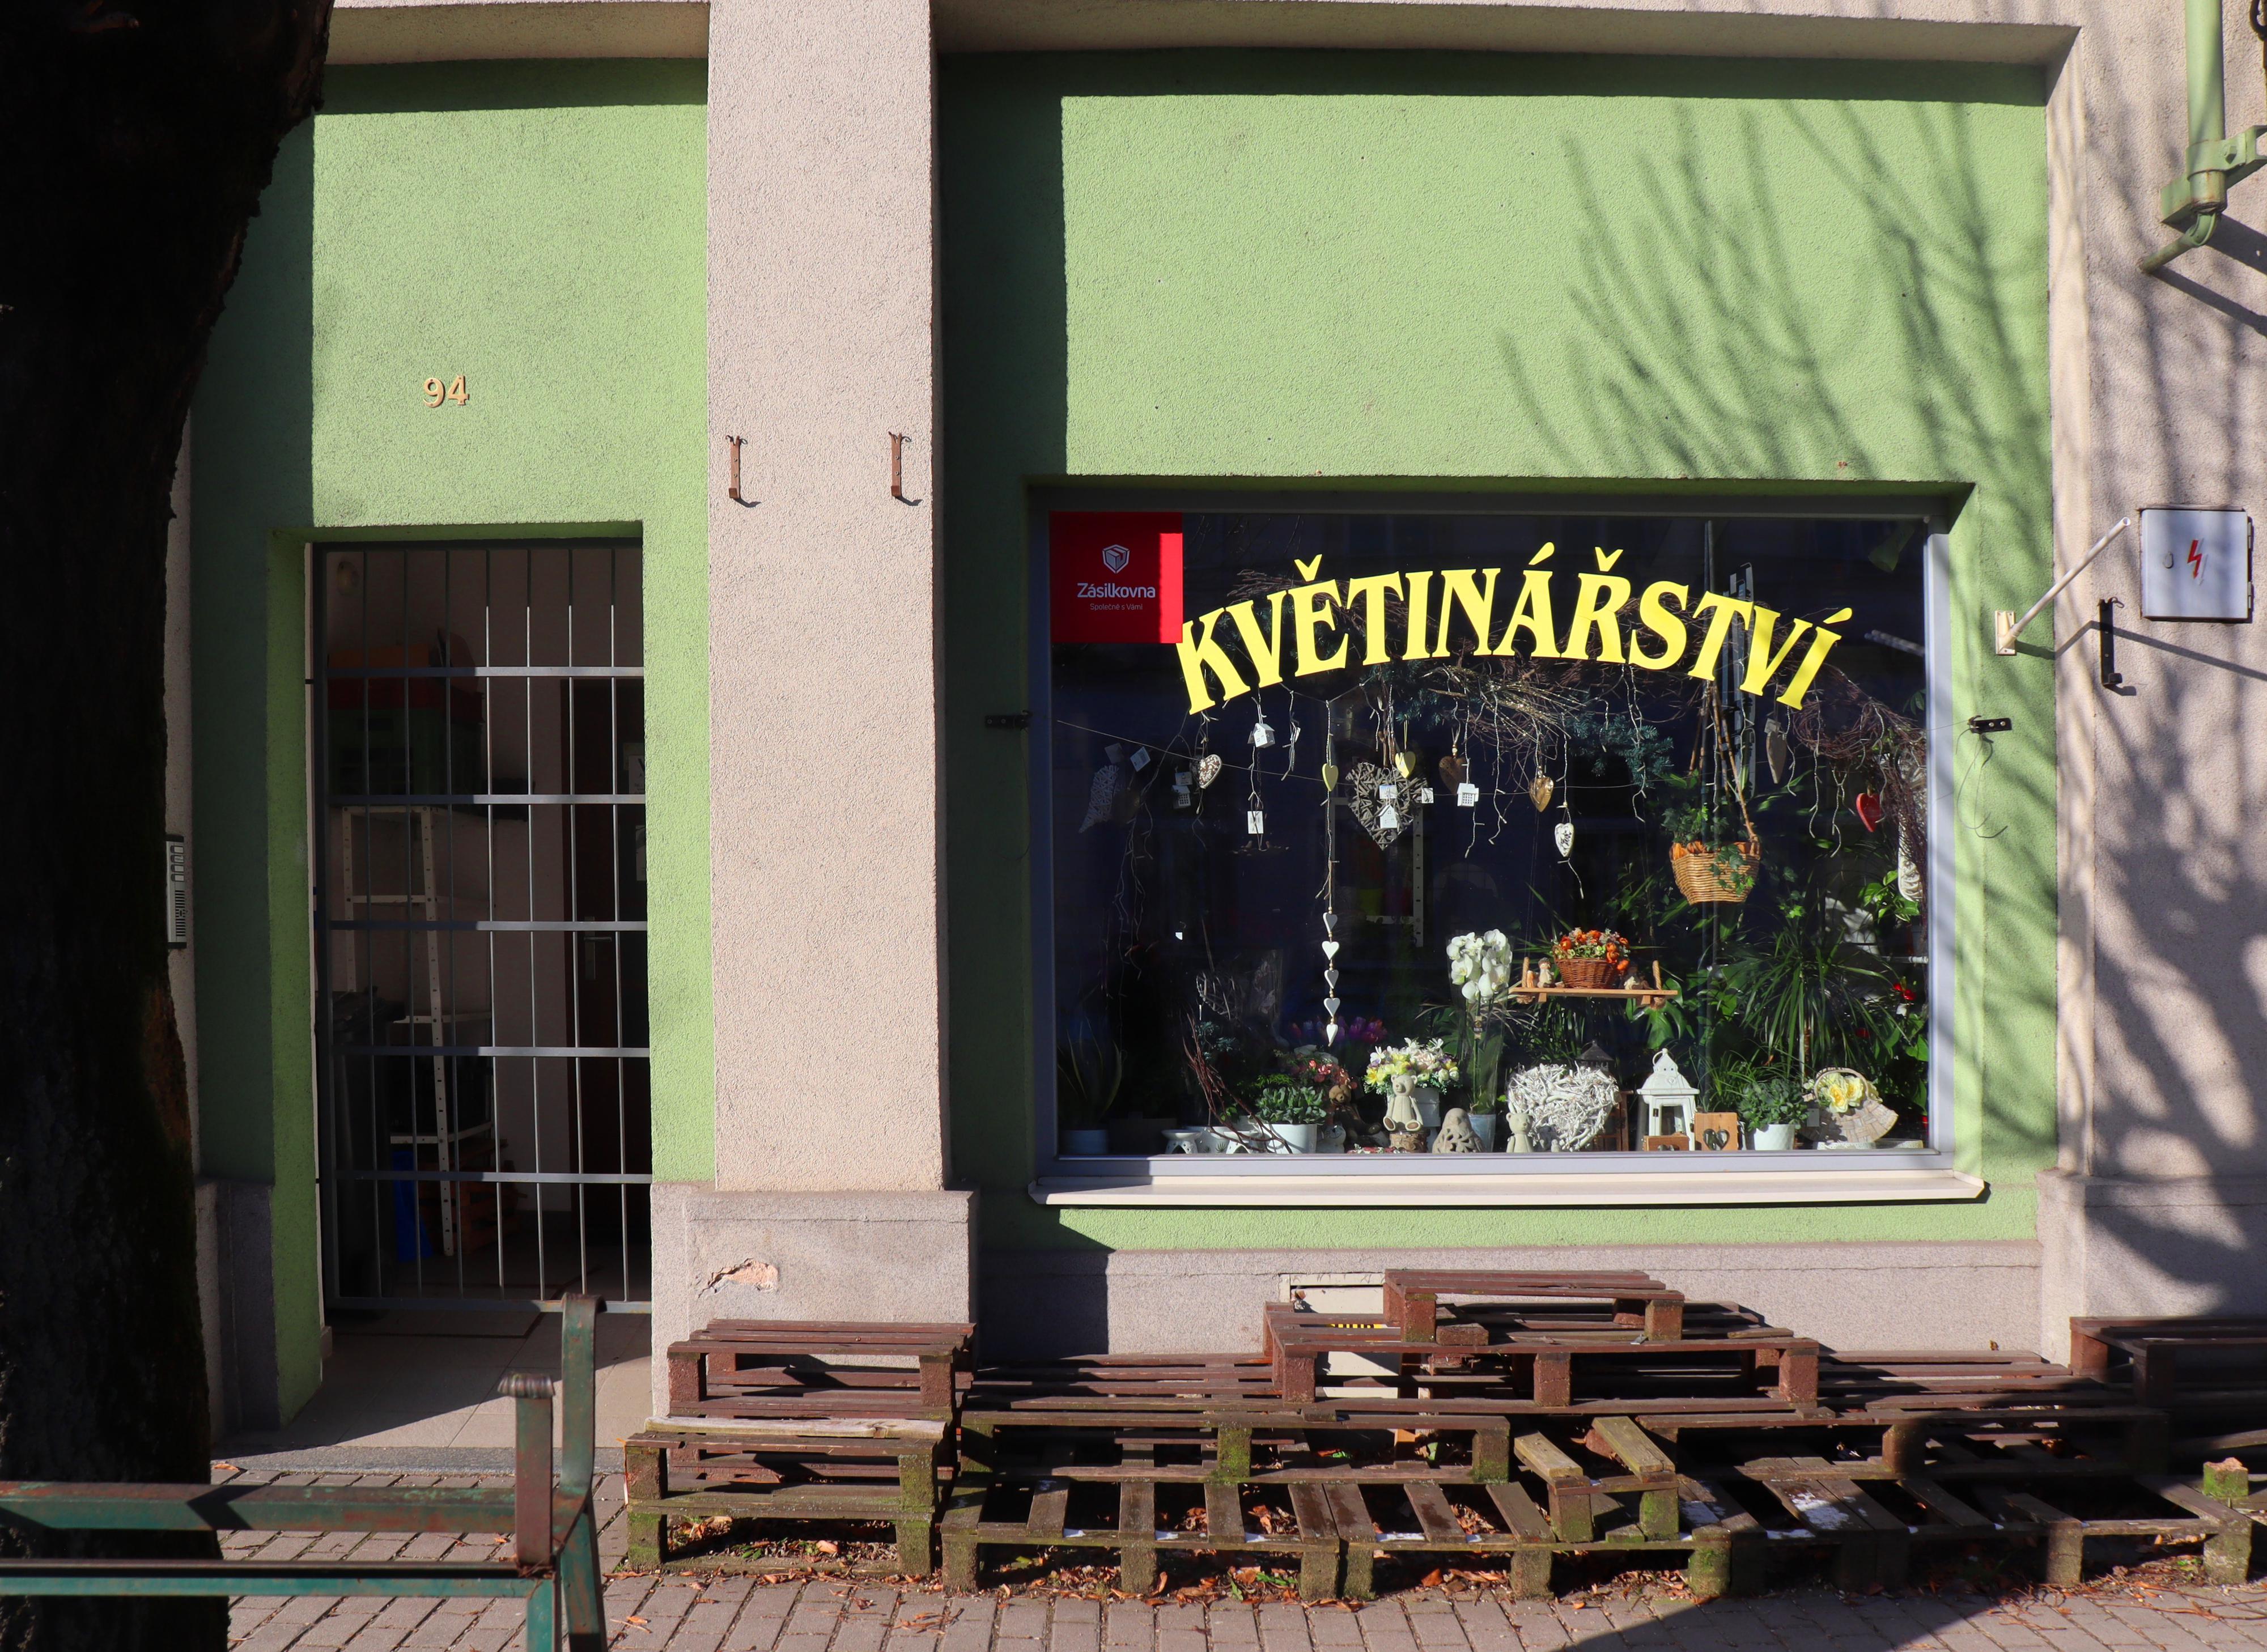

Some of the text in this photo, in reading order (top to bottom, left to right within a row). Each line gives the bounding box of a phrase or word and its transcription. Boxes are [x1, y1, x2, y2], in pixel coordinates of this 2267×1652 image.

[422, 374, 470, 408] 94
[1077, 583, 1156, 598] Zásilkovna
[1175, 542, 1852, 715] KVĚTINÁŘSTVÍ
